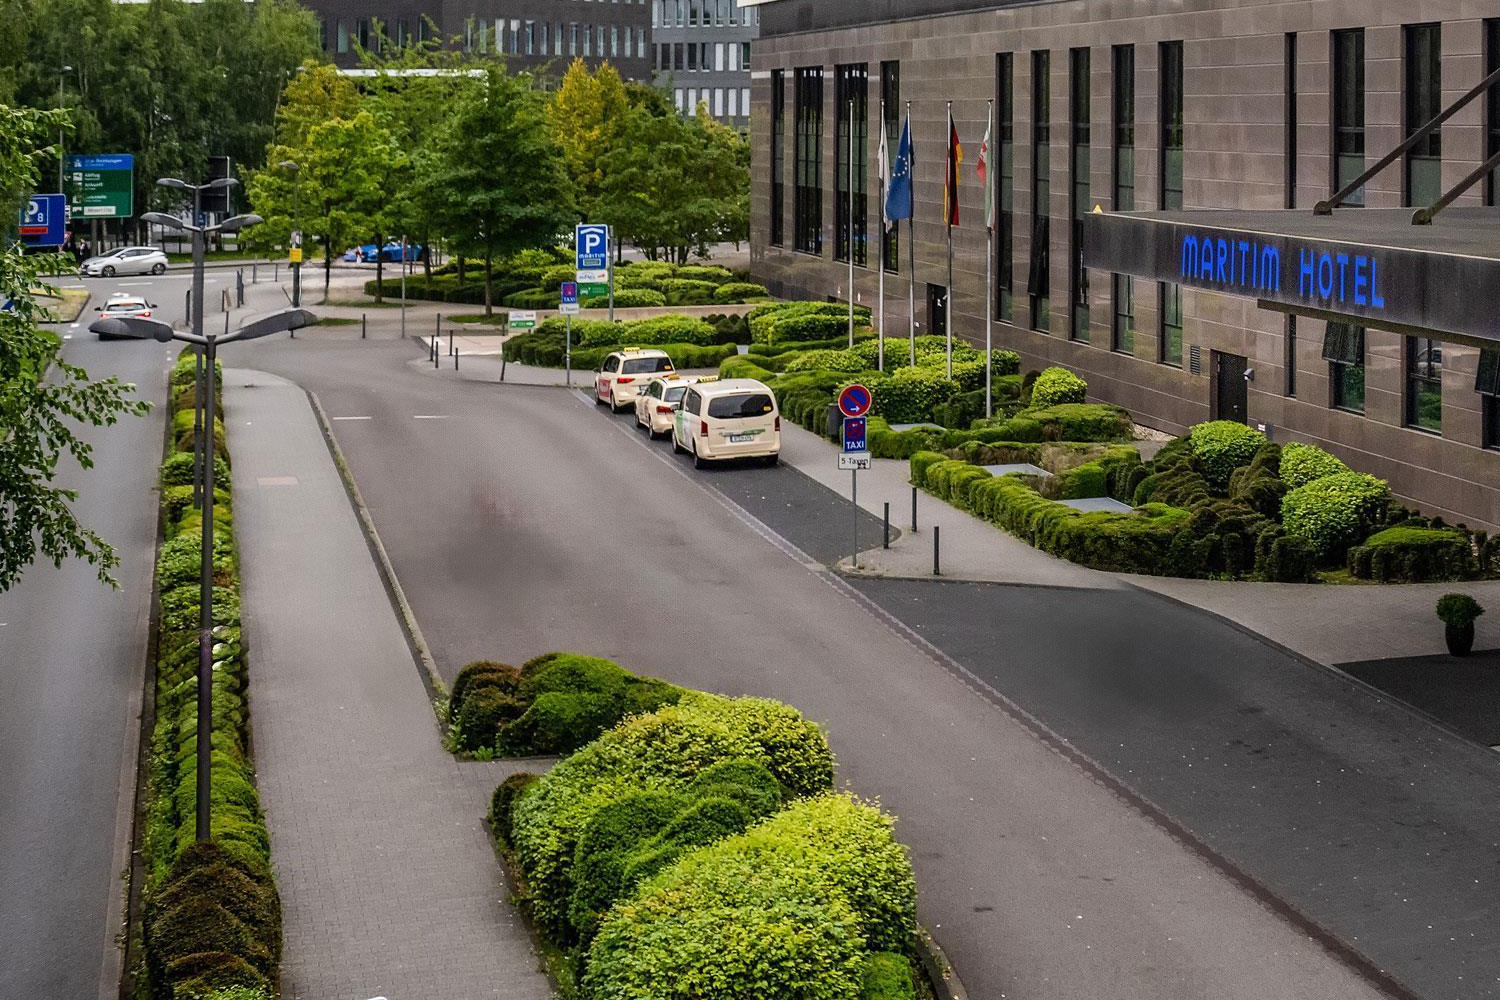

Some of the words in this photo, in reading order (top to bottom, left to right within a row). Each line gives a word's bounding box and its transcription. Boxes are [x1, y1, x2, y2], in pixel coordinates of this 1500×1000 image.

[37, 212, 44, 223] 8
[586, 234, 601, 254] P
[1182, 234, 1280, 293] MARITIM
[1299, 248, 1385, 309] HOTEL
[846, 440, 865, 449] TAXI
